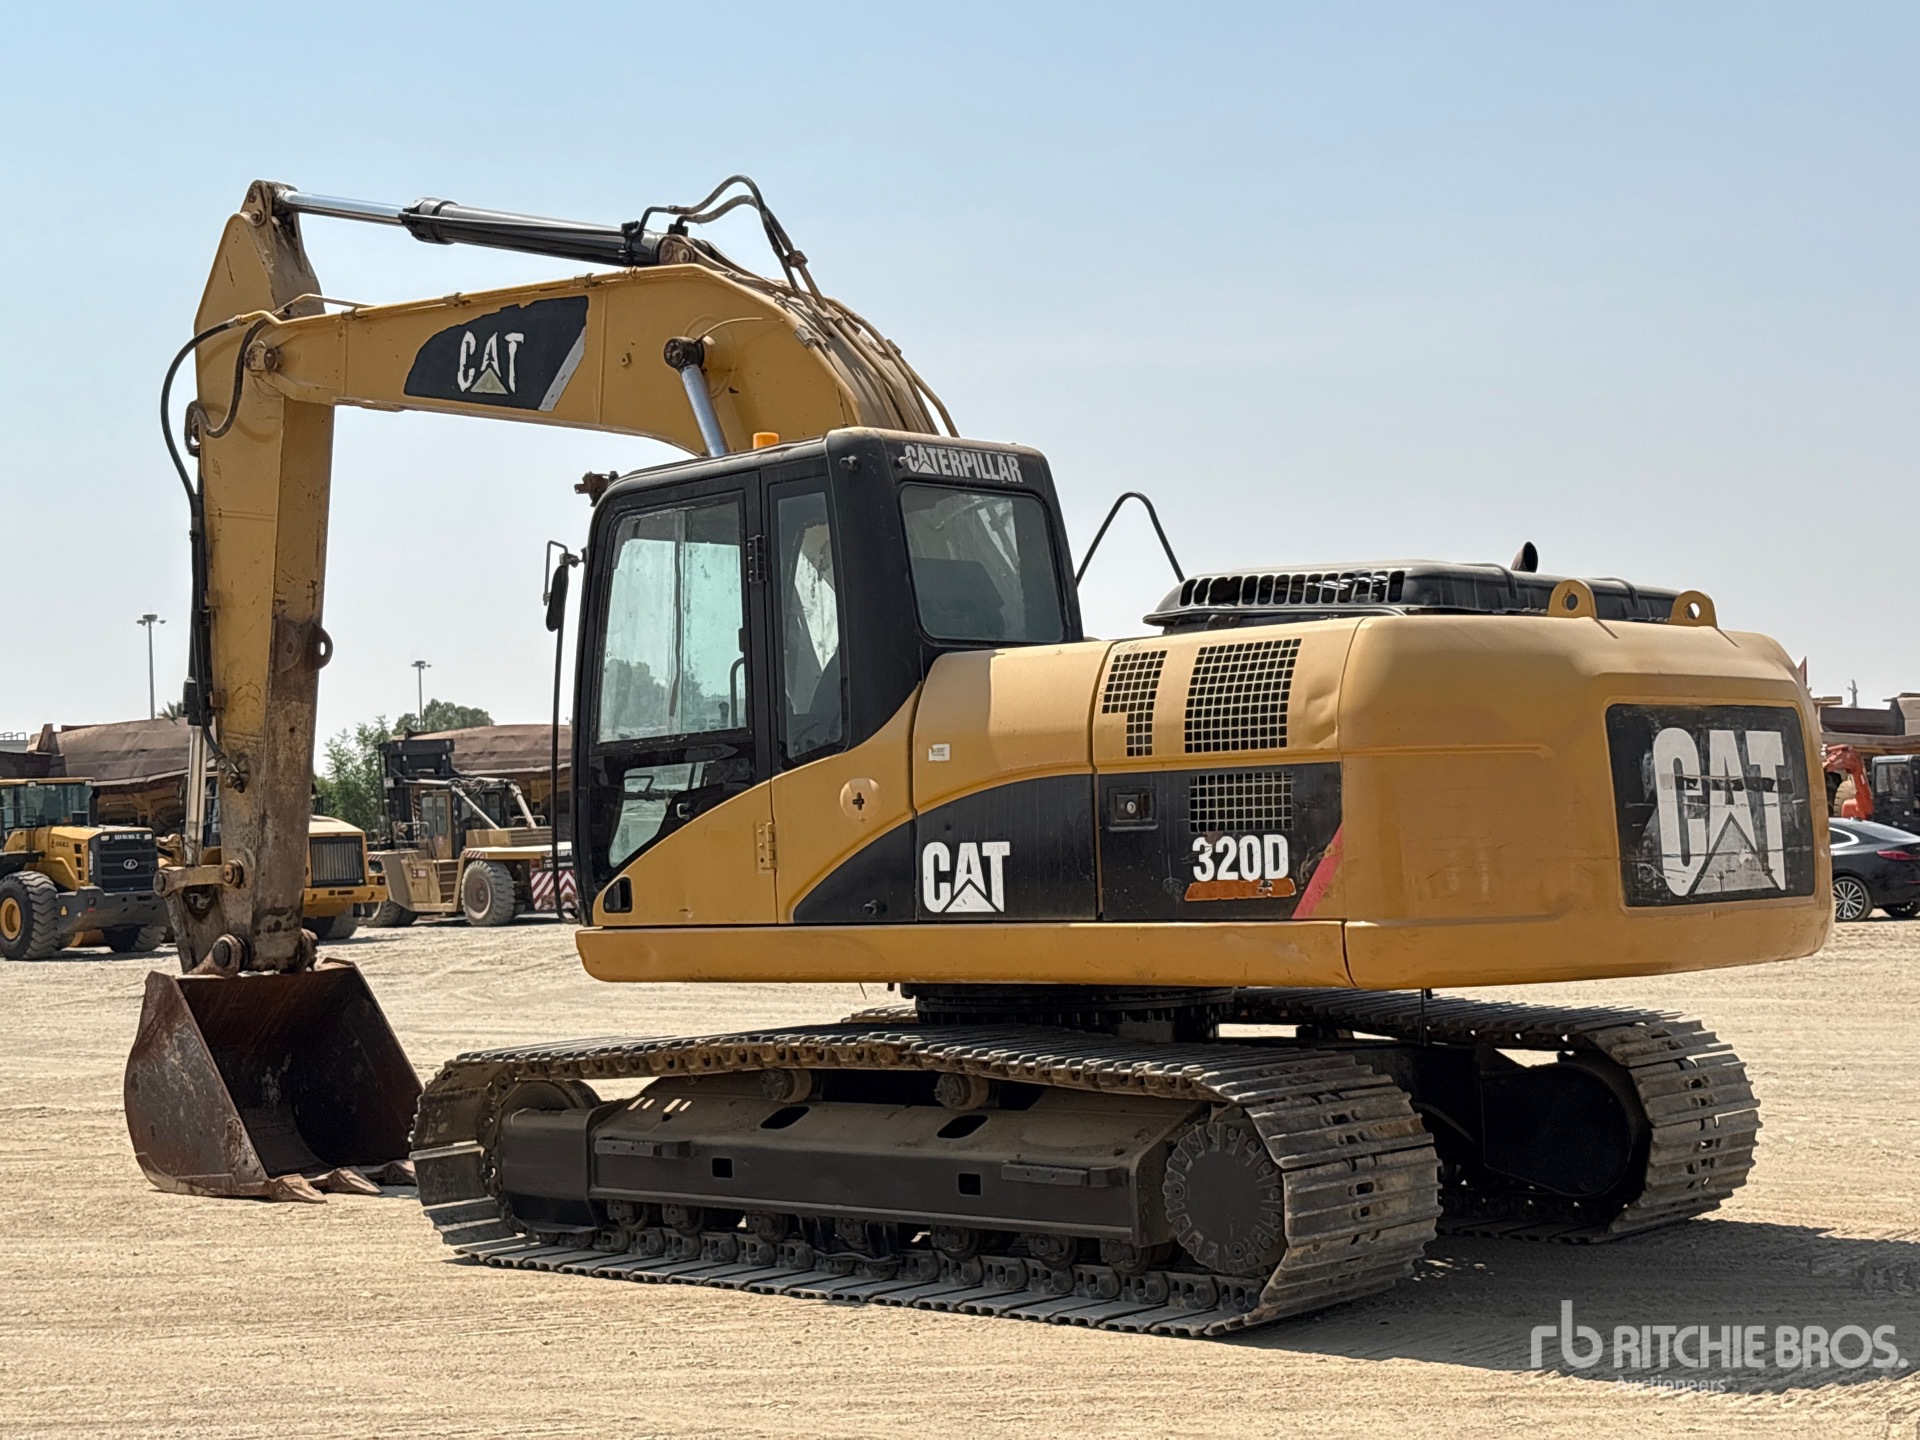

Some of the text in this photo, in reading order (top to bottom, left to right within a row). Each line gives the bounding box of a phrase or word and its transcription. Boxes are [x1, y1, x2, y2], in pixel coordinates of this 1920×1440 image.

[457, 330, 525, 394] CAT
[904, 444, 1023, 482] CATERPILLAR
[1653, 727, 1786, 896] CAT
[922, 841, 1011, 913] CAT
[1192, 834, 1289, 882] 320D
